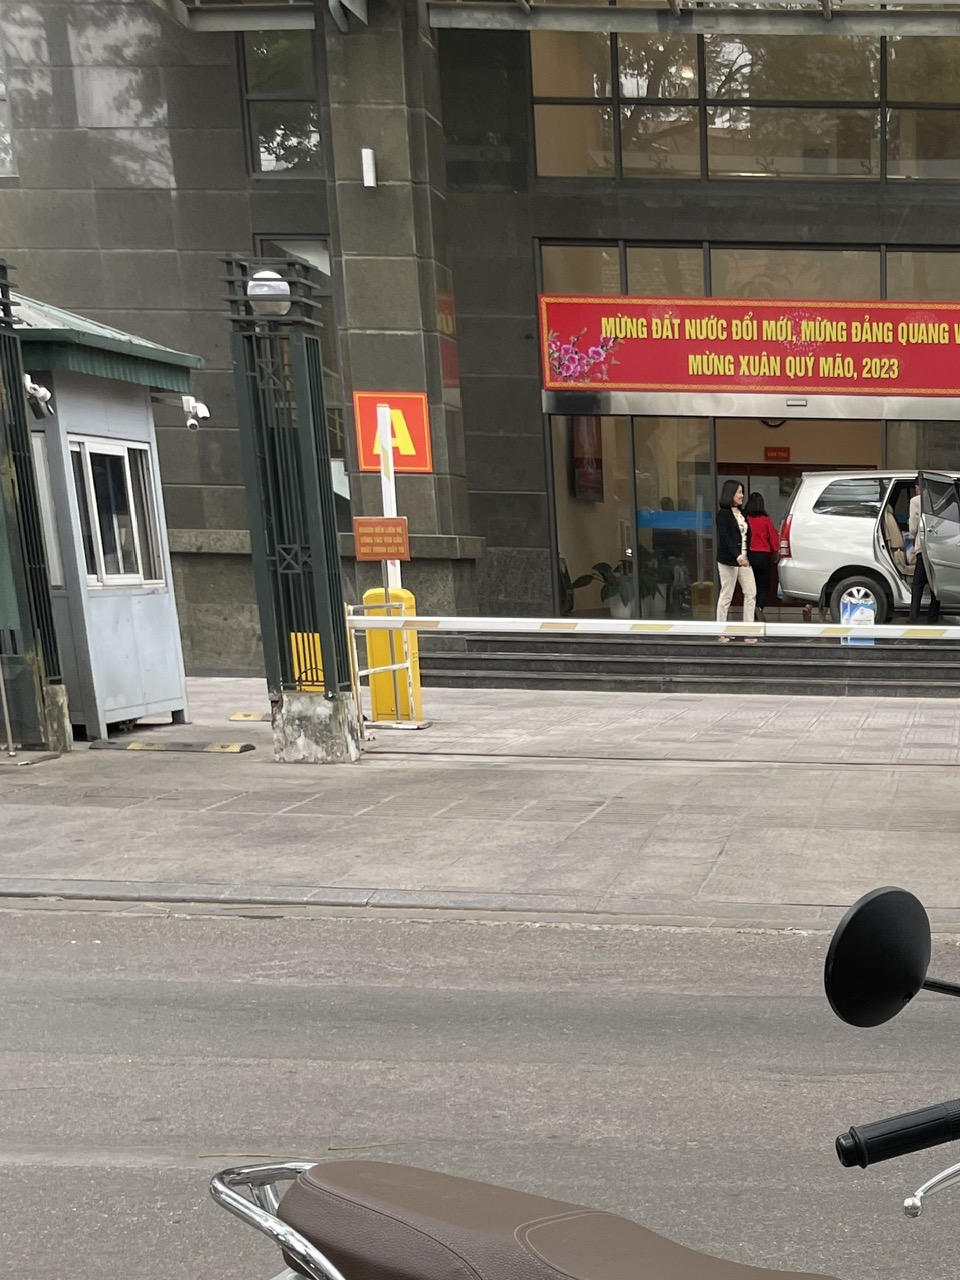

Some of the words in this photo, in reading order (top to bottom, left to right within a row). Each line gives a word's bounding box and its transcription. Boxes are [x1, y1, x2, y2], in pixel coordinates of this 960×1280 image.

[601, 313, 648, 339] MỪNG
[652, 311, 681, 340] ĐẤT
[685, 315, 728, 340] NƯỚC
[732, 311, 758, 341] ĐỔI
[762, 315, 797, 343] MỚI,
[801, 316, 847, 343] MỪNG
[851, 315, 894, 343] ĐẢNG
[898, 322, 949, 346] QUANG
[688, 350, 735, 376] MỪNG
[739, 351, 781, 377] XUÂN
[785, 352, 815, 379] QUÝ
[819, 353, 858, 380] MÃO,
[862, 358, 899, 379] 2023
[372, 408, 417, 456] A
